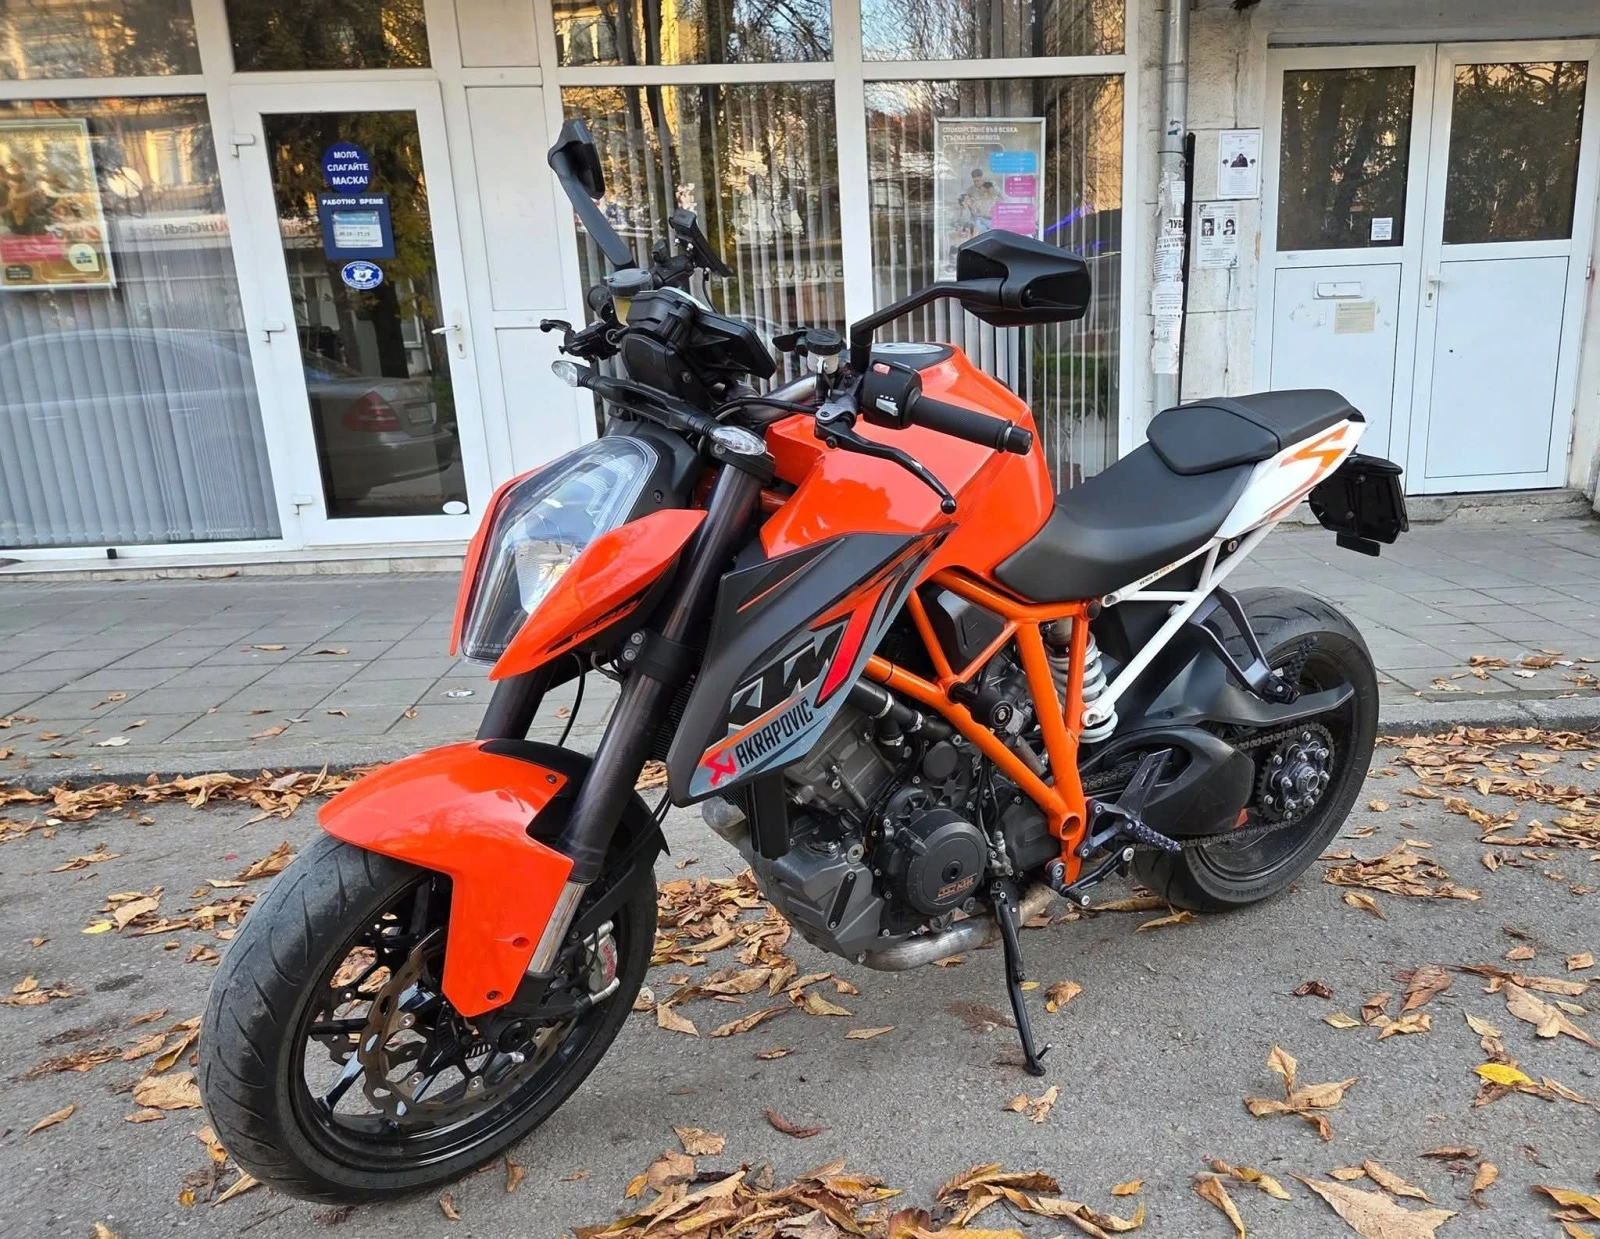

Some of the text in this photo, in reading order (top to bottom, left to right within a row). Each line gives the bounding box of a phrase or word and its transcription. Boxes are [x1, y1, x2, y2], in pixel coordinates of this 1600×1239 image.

[333, 151, 360, 160] МОЛЯ,
[327, 162, 370, 172] СЛАГАЙТЕ
[332, 176, 369, 185] МАСКА!
[704, 625, 845, 751] KTM
[735, 697, 814, 767] AKRAPOVIČ
